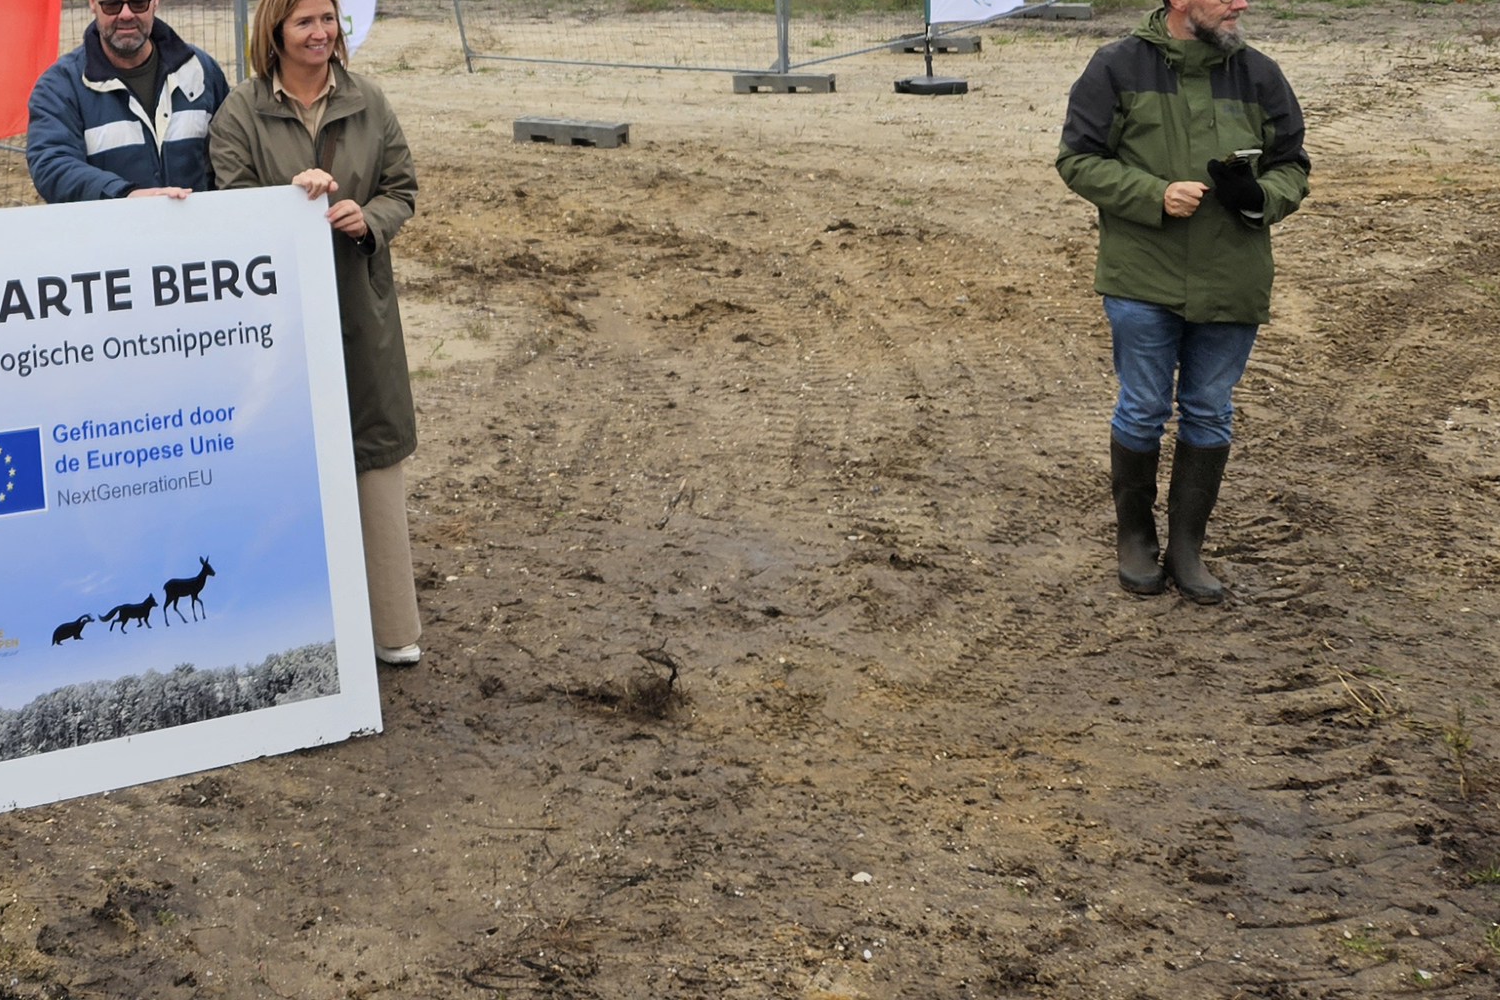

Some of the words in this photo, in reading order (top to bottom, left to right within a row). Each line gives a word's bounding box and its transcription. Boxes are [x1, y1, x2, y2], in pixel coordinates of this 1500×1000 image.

[151, 255, 278, 307] BERG
[102, 321, 274, 358] Ontsnippering
[52, 409, 183, 443] Gefinancierd
[190, 406, 235, 426] door
[55, 454, 80, 474] de
[87, 442, 184, 468] Europese
[190, 433, 235, 455] Unie
[57, 468, 213, 507] NextGenerationEU
